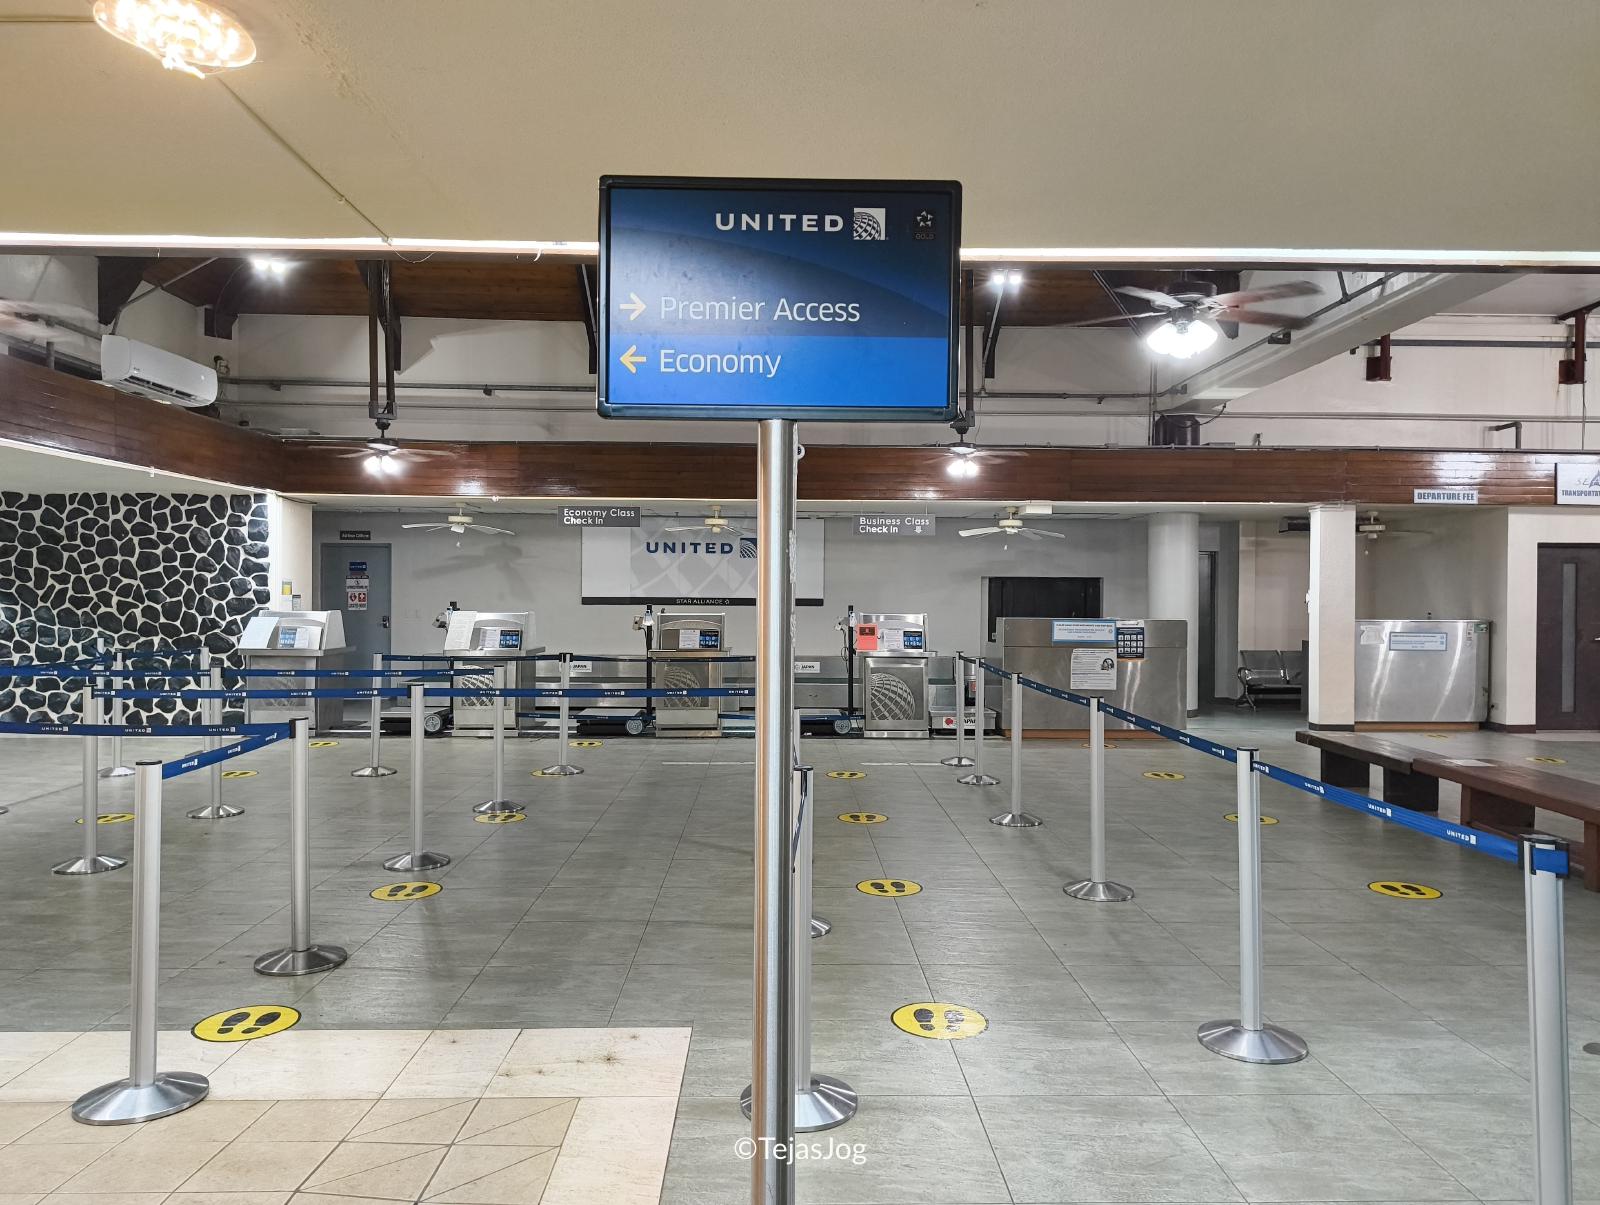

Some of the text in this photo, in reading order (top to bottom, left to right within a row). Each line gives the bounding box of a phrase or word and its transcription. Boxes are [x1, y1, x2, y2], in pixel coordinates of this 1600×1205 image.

[714, 213, 844, 232] UNITED
[660, 296, 860, 323] Premier Access
[660, 349, 781, 378] Economy
[1417, 492, 1475, 501] DEPARTURE FEE
[564, 508, 635, 518] Economy Class
[564, 517, 603, 525] Check In
[860, 517, 929, 526] Business Class
[860, 525, 898, 533] Check In
[646, 542, 734, 554] UNITED
[1305, 781, 1320, 791] UNITED
[1368, 803, 1386, 814] UNITED
[1447, 829, 1469, 841] UNITED
